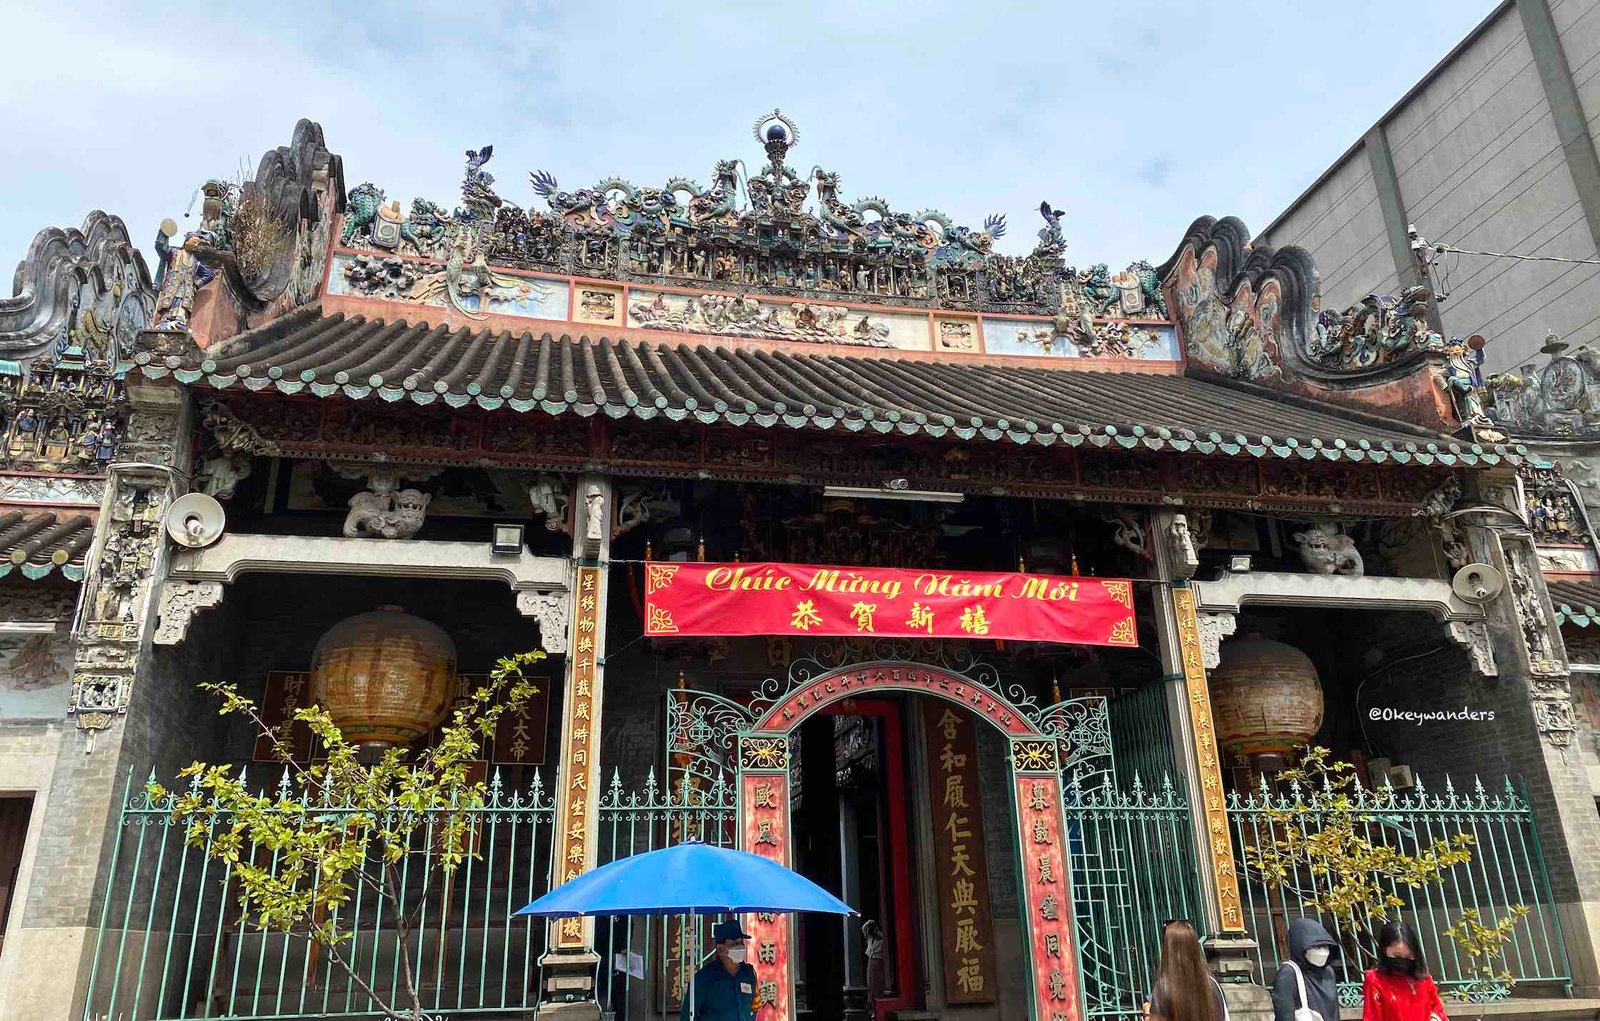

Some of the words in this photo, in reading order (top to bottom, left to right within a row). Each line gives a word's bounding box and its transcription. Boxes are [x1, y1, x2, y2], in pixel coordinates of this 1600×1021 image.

[705, 567, 791, 591] Chúc
[799, 569, 904, 600] Mừng
[914, 573, 1006, 598] Năm
[1011, 577, 1081, 602] Mới
[790, 599, 991, 635] 恭賀新禧
